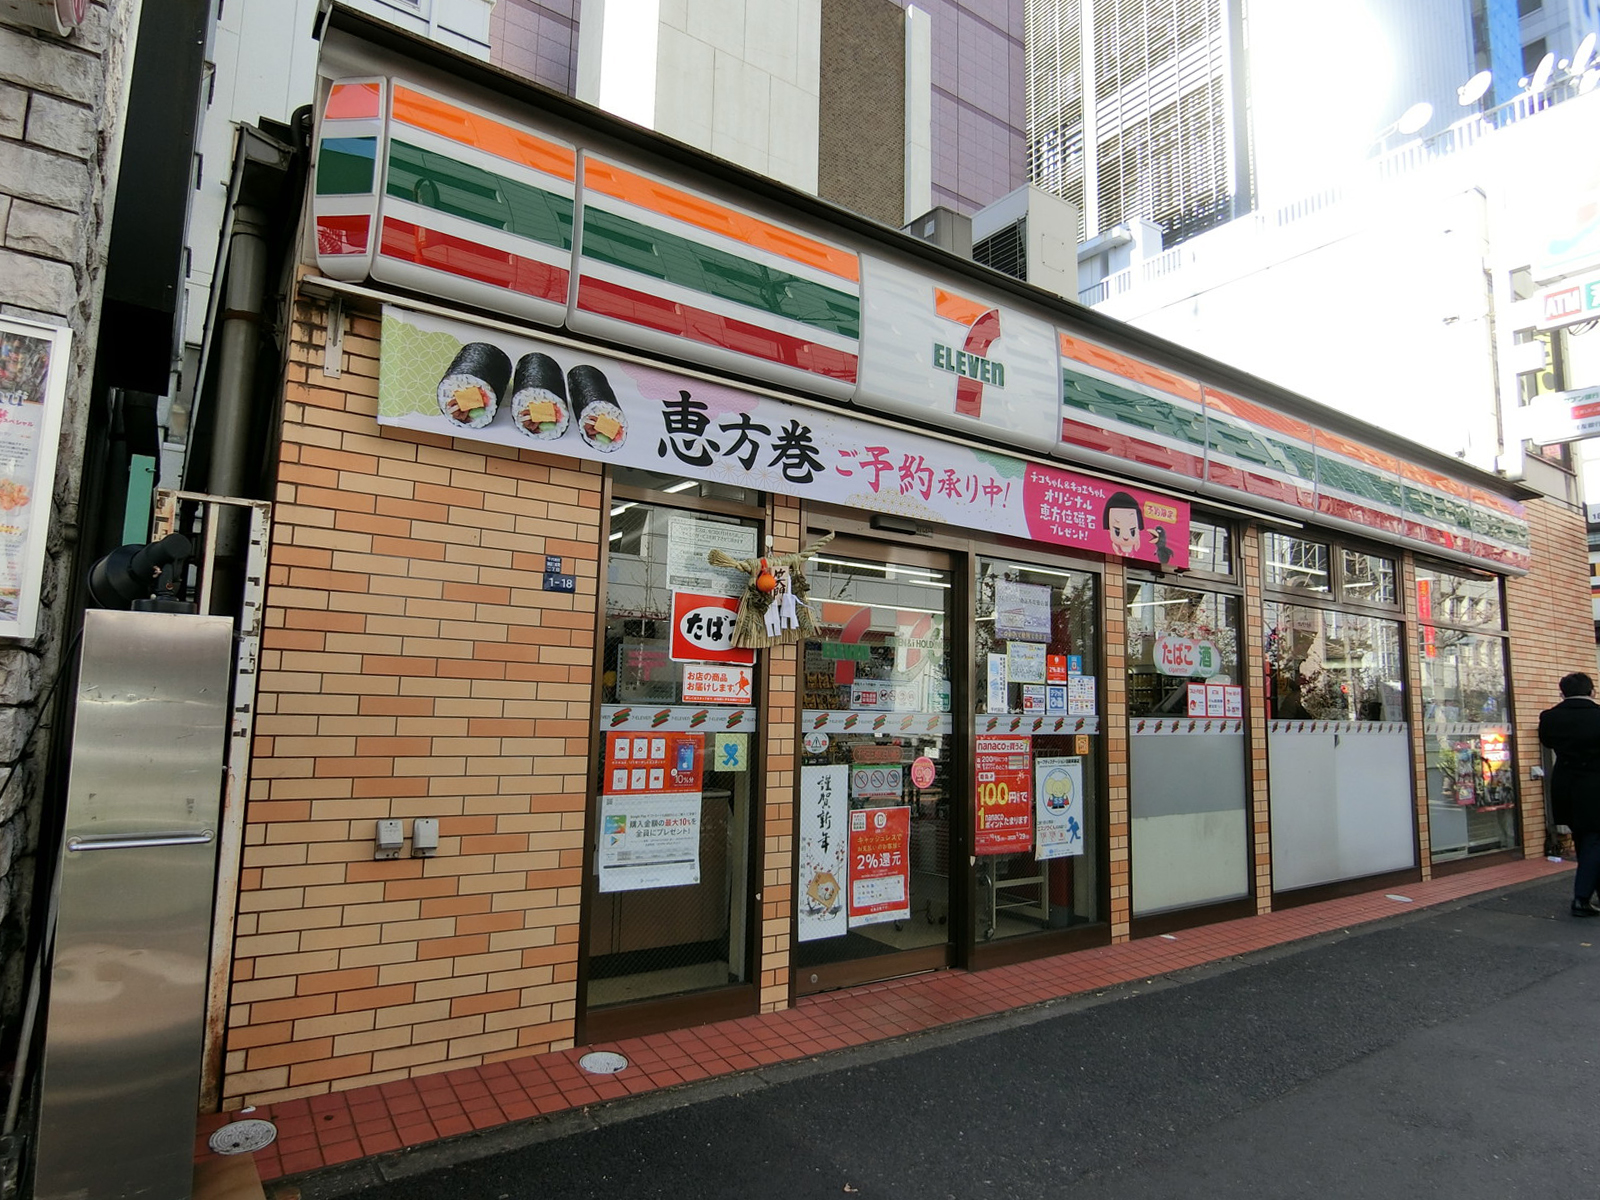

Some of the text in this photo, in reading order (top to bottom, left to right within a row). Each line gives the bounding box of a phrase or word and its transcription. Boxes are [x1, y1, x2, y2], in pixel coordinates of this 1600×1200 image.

[657, 390, 1011, 510] 恵方巻 ご予約承り中!
[1044, 489, 1093, 511] オリジナル
[1039, 503, 1097, 530] 恵方位磁石
[1050, 524, 1089, 541] プレゼント!
[548, 577, 573, 589] 1-18
[1161, 642, 1194, 666] たばこ
[1198, 645, 1212, 668] 酒
[687, 671, 728, 682] お店の商品
[816, 775, 833, 855] 謹賀新年
[856, 851, 902, 870] 2%還元
